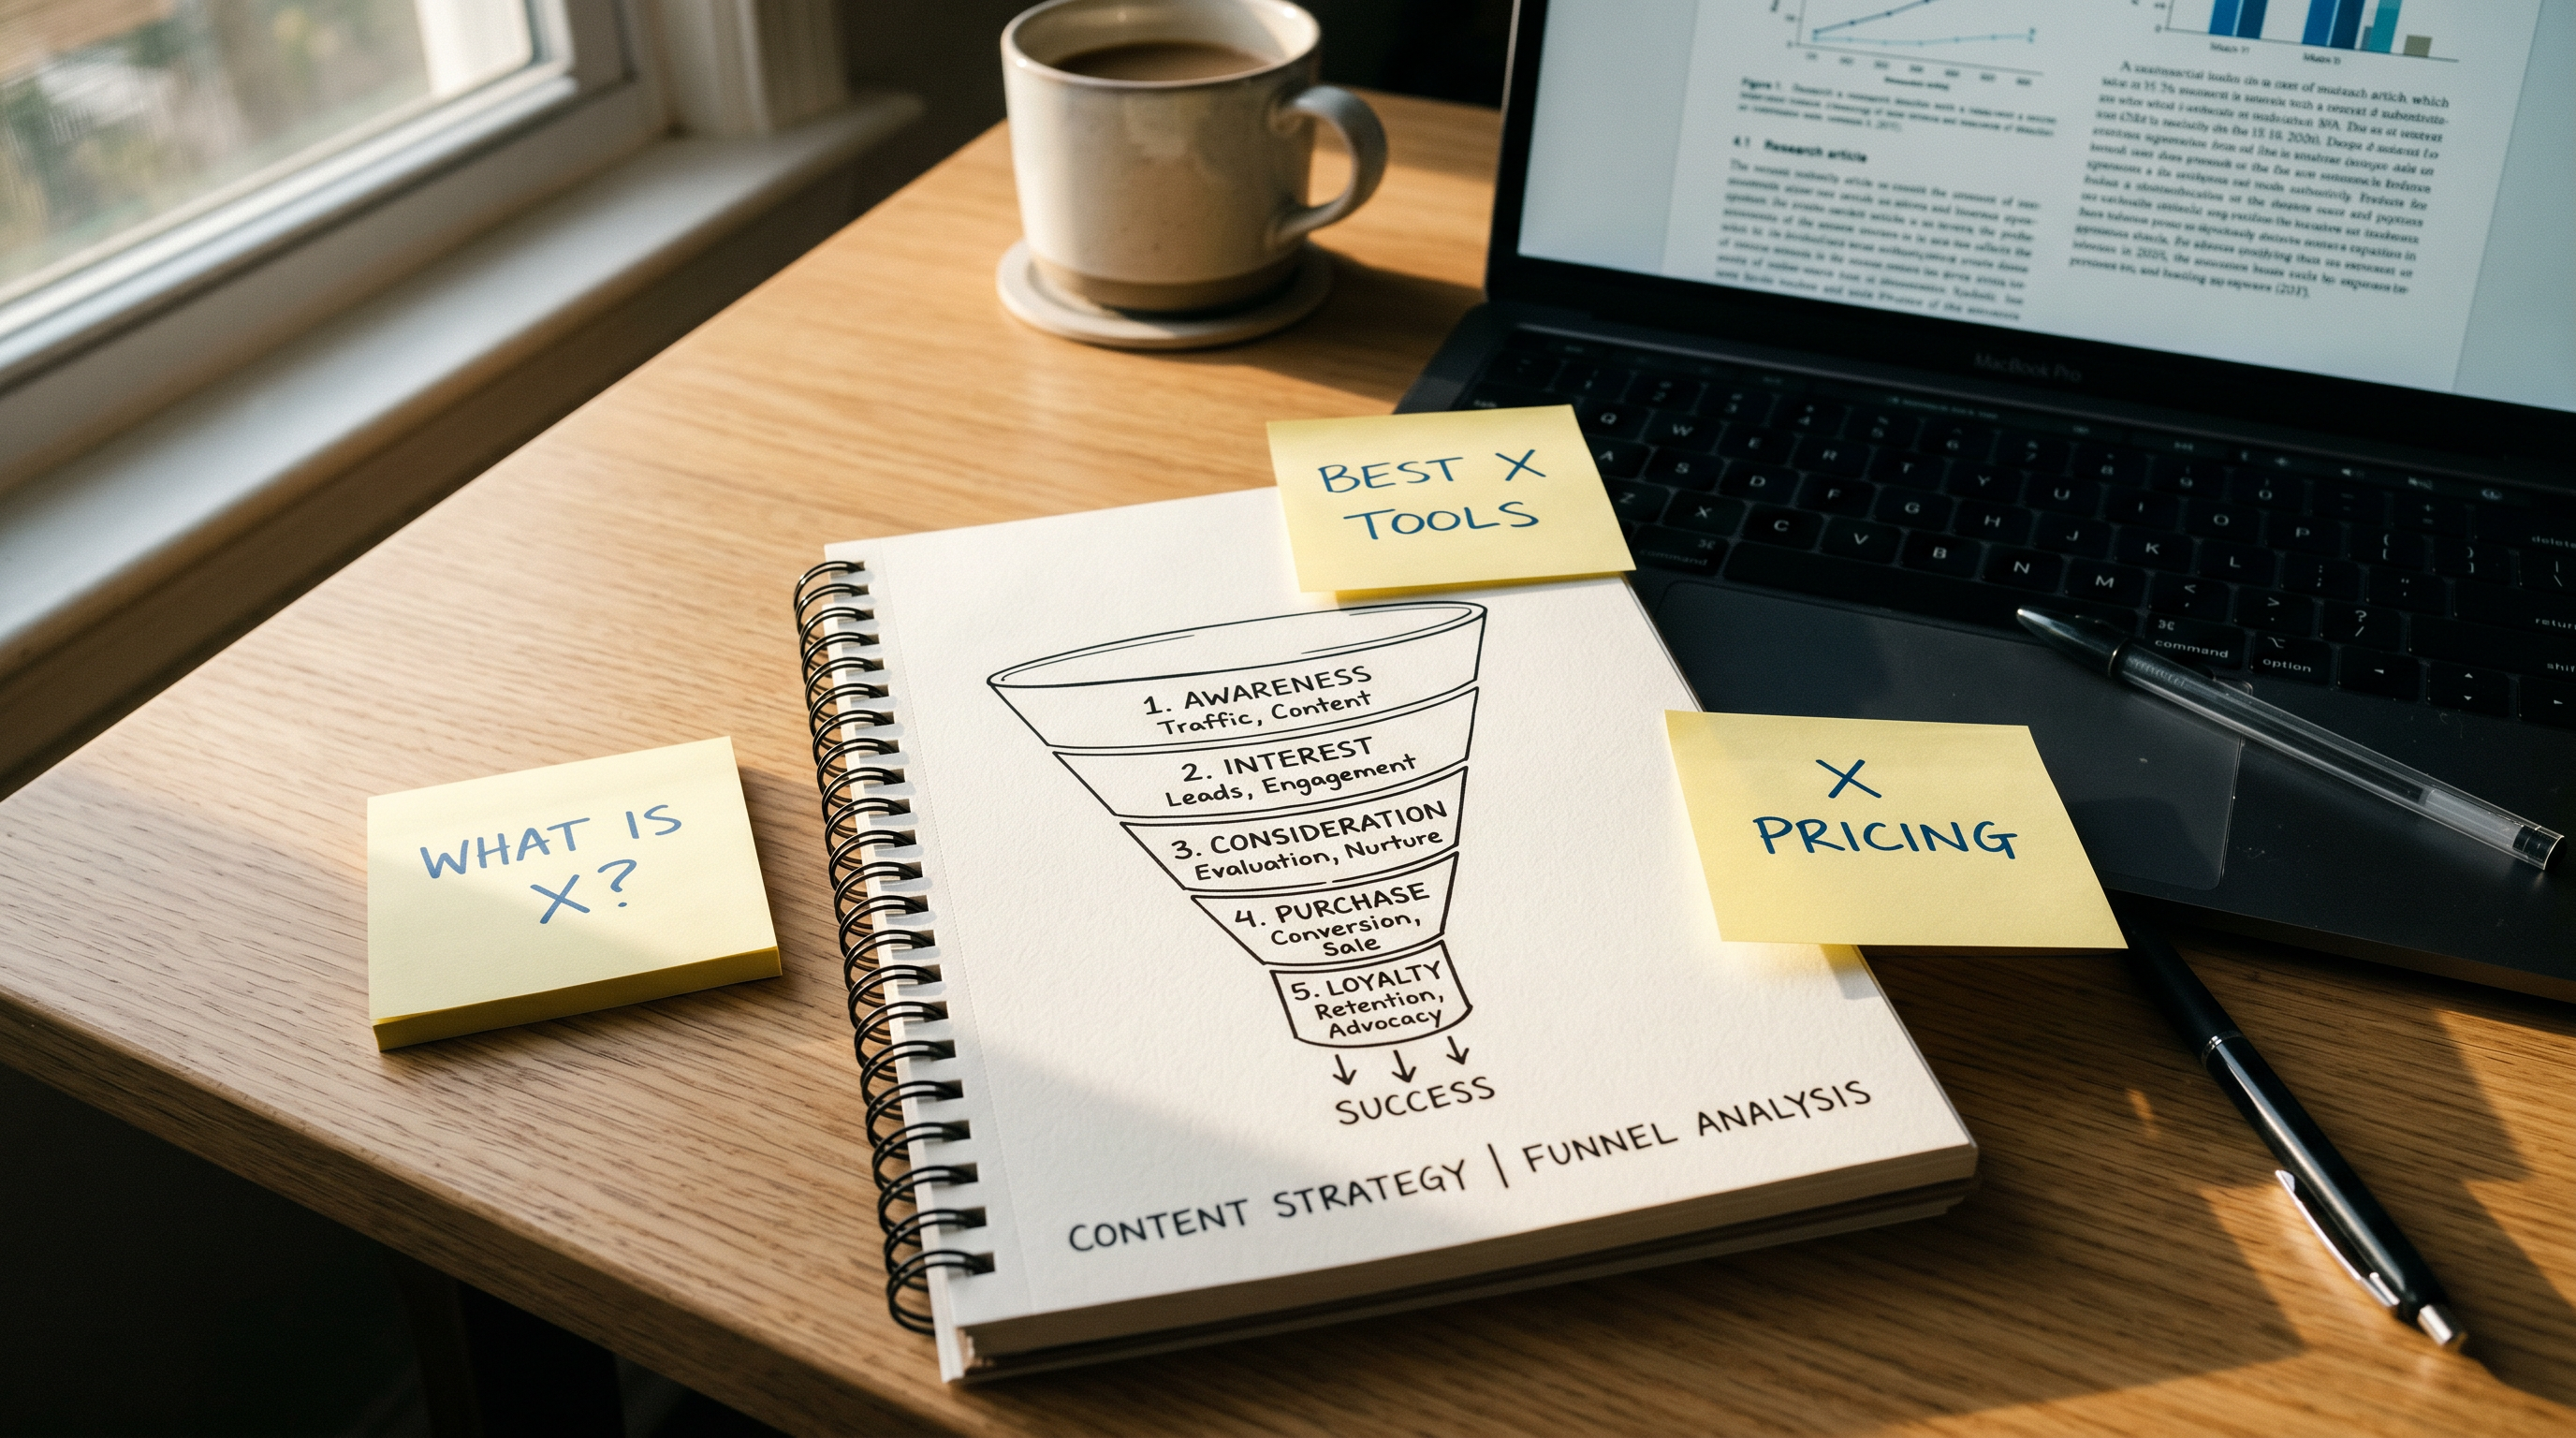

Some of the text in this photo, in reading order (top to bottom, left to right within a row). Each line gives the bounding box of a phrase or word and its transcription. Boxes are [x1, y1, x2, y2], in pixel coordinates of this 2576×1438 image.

[2120, 60, 2131, 72] A
[2302, 81, 2316, 93] of
[2411, 93, 2450, 109] which
[1764, 138, 1823, 157] Research
[1827, 149, 1868, 164] article
[1973, 352, 2084, 384] MacBook Pro
[1601, 413, 1617, 424] Q
[1673, 424, 1692, 436] W
[1749, 438, 1759, 448] E
[1946, 440, 1959, 449] 6
[1600, 451, 1613, 461] A
[1822, 450, 1837, 461] R
[1318, 449, 1545, 492] BEST X
[1676, 462, 1689, 474] S
[1900, 462, 1914, 474] T
[1749, 476, 1765, 487] D
[1978, 476, 1990, 486] Y
[1619, 492, 1635, 504] Z
[1827, 488, 1842, 500] F
[2054, 489, 2070, 500] U
[1694, 506, 1712, 519] X
[1905, 503, 1920, 513] G
[1343, 501, 1539, 540] TOOLS
[1774, 520, 1789, 531] C
[1984, 515, 2000, 527] H
[2067, 531, 2079, 541] J
[2295, 527, 2310, 537] P
[1854, 533, 1868, 545] V
[1933, 547, 1947, 559] B
[2145, 543, 2159, 554] K
[1639, 547, 1708, 567] command
[2230, 556, 2240, 567] L
[2013, 561, 2030, 574] N
[2096, 575, 2115, 588] M
[2355, 609, 2367, 622] ?
[2536, 618, 2576, 630] retur
[2155, 639, 2229, 659] command
[2262, 659, 2311, 672] option
[2547, 663, 2575, 672] shif
[1144, 666, 1372, 715] 1. AWARENESS
[1157, 690, 1370, 735] Traffic, Content
[1181, 736, 1371, 782] 2. INTEREST
[1165, 753, 1416, 807] Leads, Engagement
[1816, 759, 1881, 799] X
[1172, 800, 1447, 859] 3. CONSIDERATION
[420, 805, 681, 878] WHAT IS
[1752, 816, 2017, 859] PRICING
[1195, 831, 1442, 880] Evaluation, Nurture
[531, 859, 637, 924] X?
[1235, 882, 1429, 928] 4. PURCHASE
[1271, 911, 1421, 946] Conversion,
[1323, 938, 1381, 957] Sale
[1291, 961, 1443, 1001] 5. LOYALTY
[1314, 988, 1444, 1020] Retention,
[1329, 1008, 1442, 1039] Advocacy
[1336, 1077, 1495, 1125] SUCCESS
[1069, 1198, 1247, 1252] CONTENT
[1273, 1159, 1465, 1218] STRATEGY
[1522, 1123, 1677, 1172] FUNNEL
[1698, 1080, 1871, 1137] ANALYSIS
